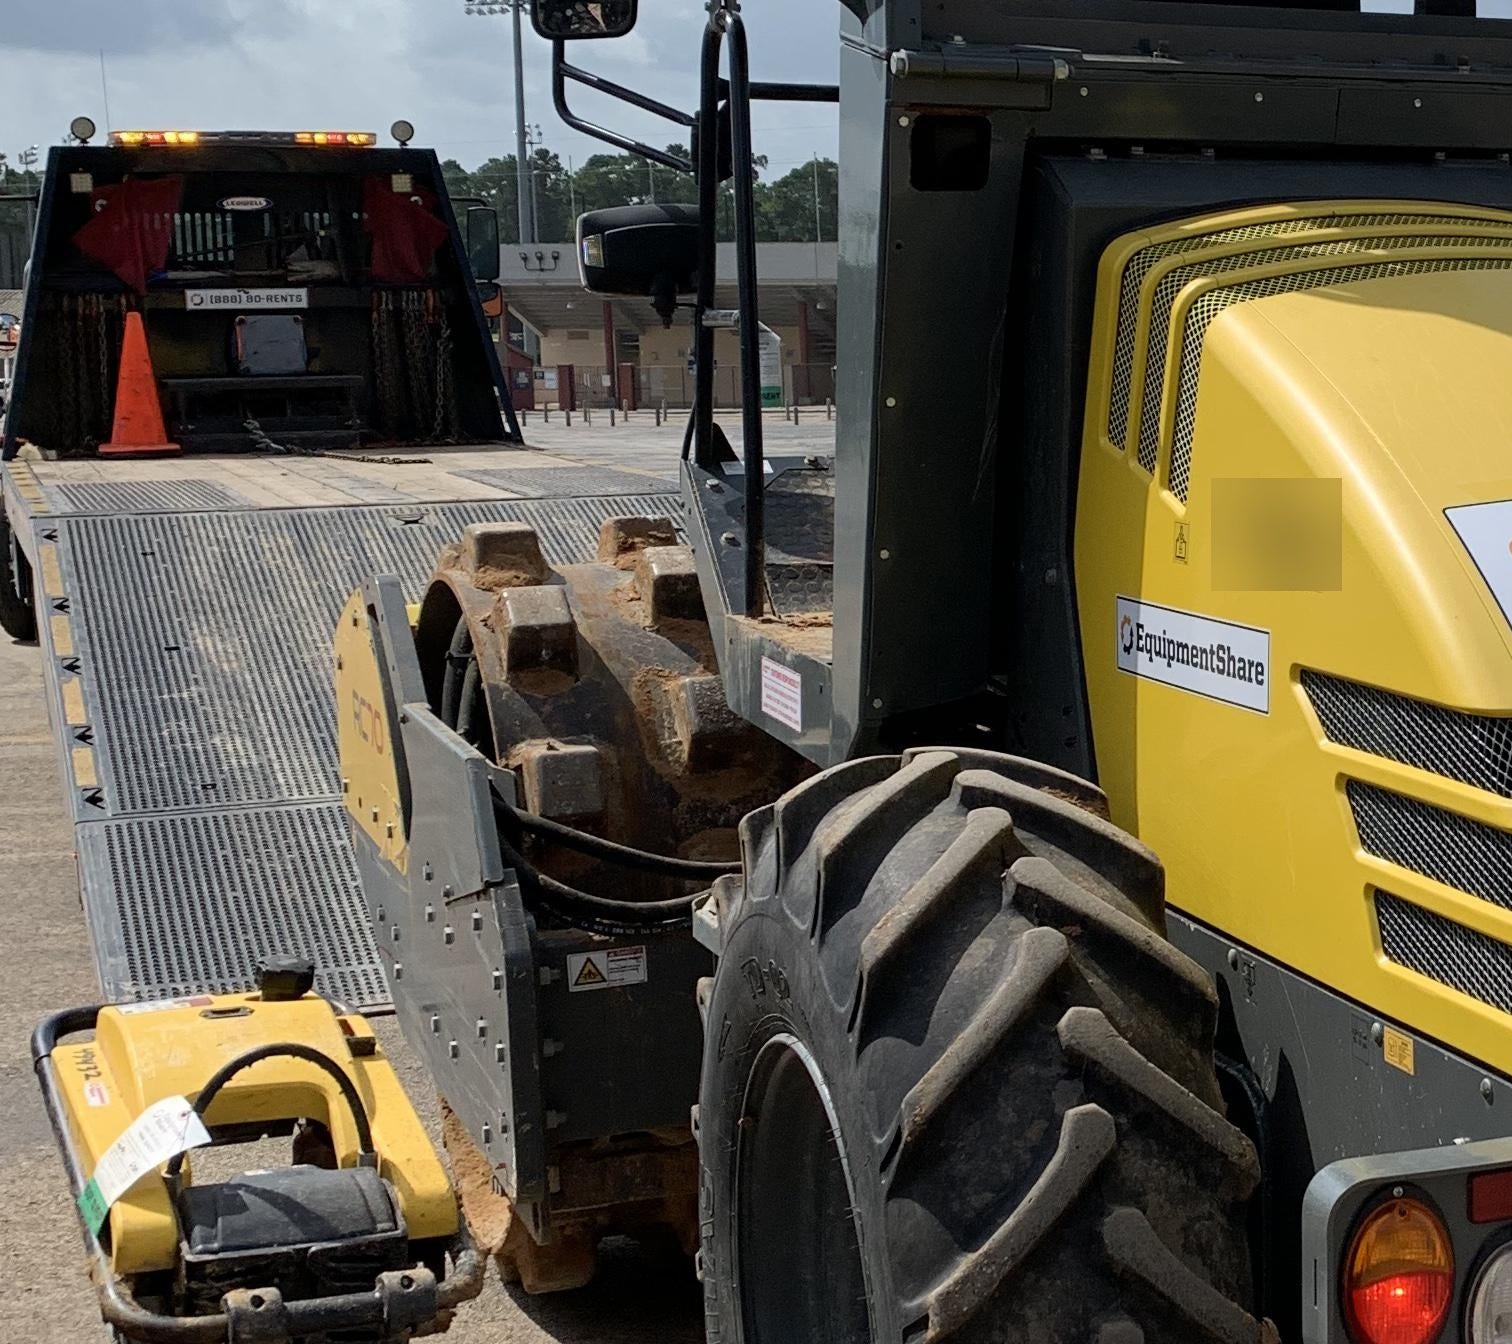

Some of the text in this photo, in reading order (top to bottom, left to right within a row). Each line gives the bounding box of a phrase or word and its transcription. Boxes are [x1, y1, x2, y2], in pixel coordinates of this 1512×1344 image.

[210, 294, 303, 305] (888) 80-RENTS
[1135, 622, 1265, 686] EquipmentShare
